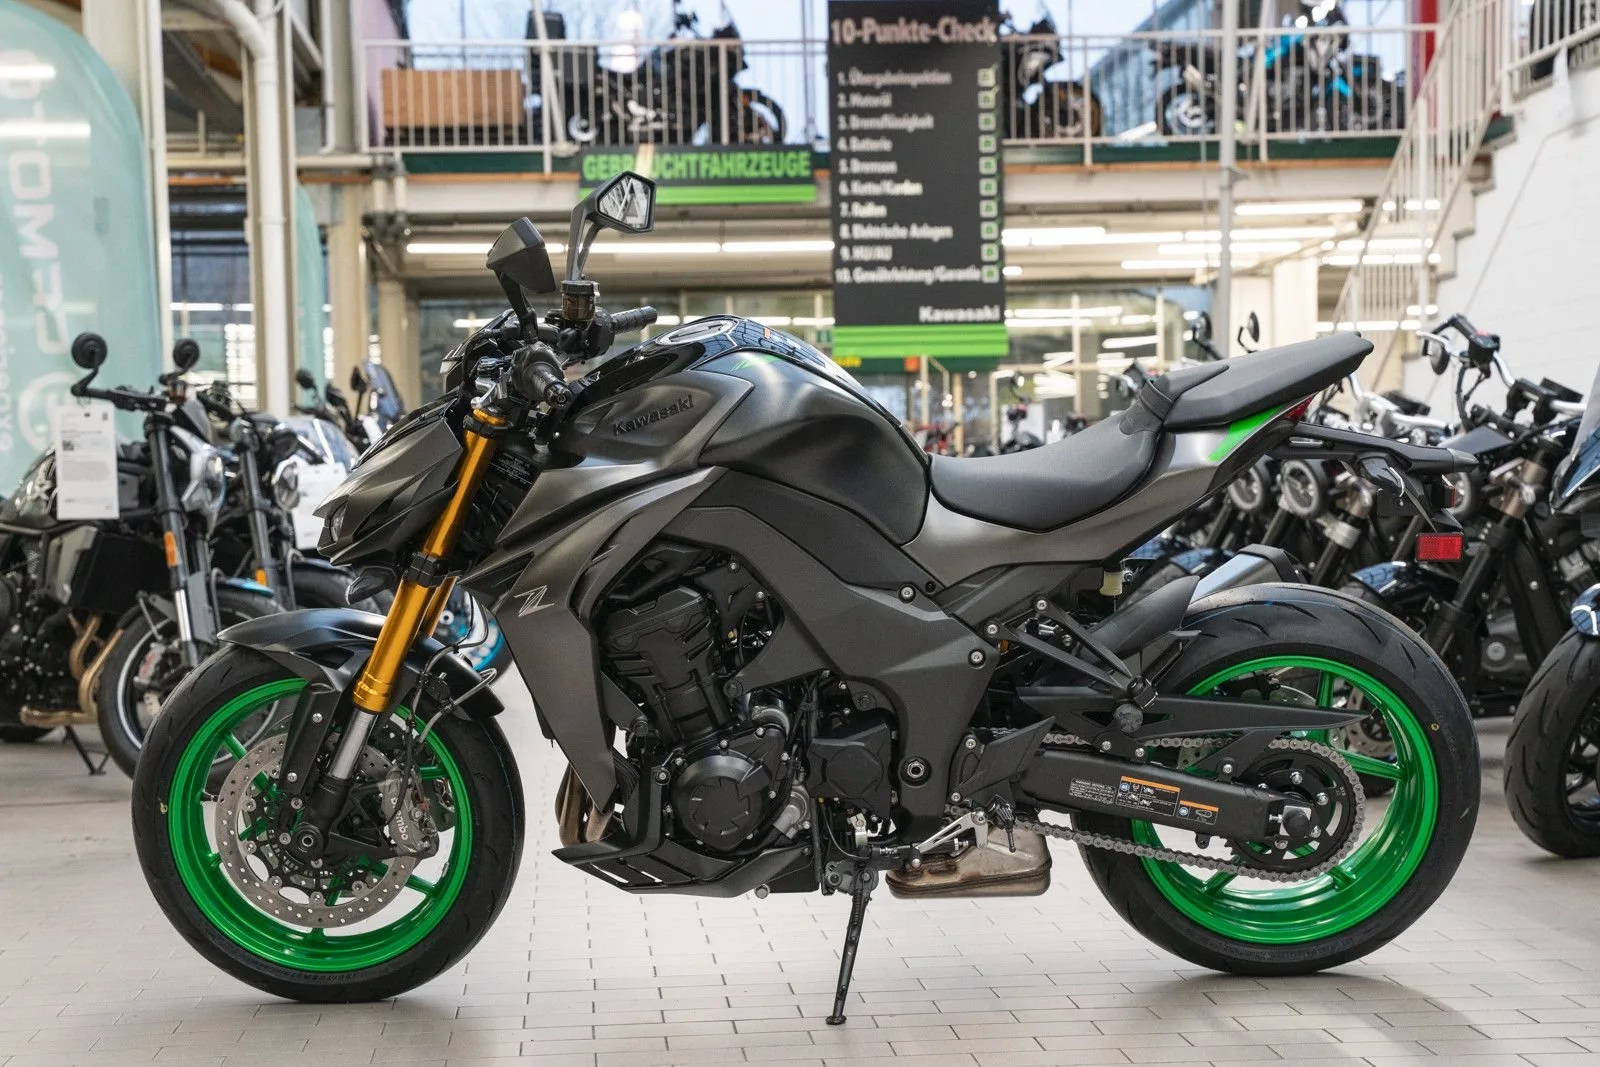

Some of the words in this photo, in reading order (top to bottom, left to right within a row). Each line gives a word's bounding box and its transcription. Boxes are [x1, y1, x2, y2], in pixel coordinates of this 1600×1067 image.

[582, 151, 812, 181] GEBRUCHTFAHRZEUGE
[919, 305, 1001, 322] Kawasaki
[613, 394, 694, 437] Kawasaki
